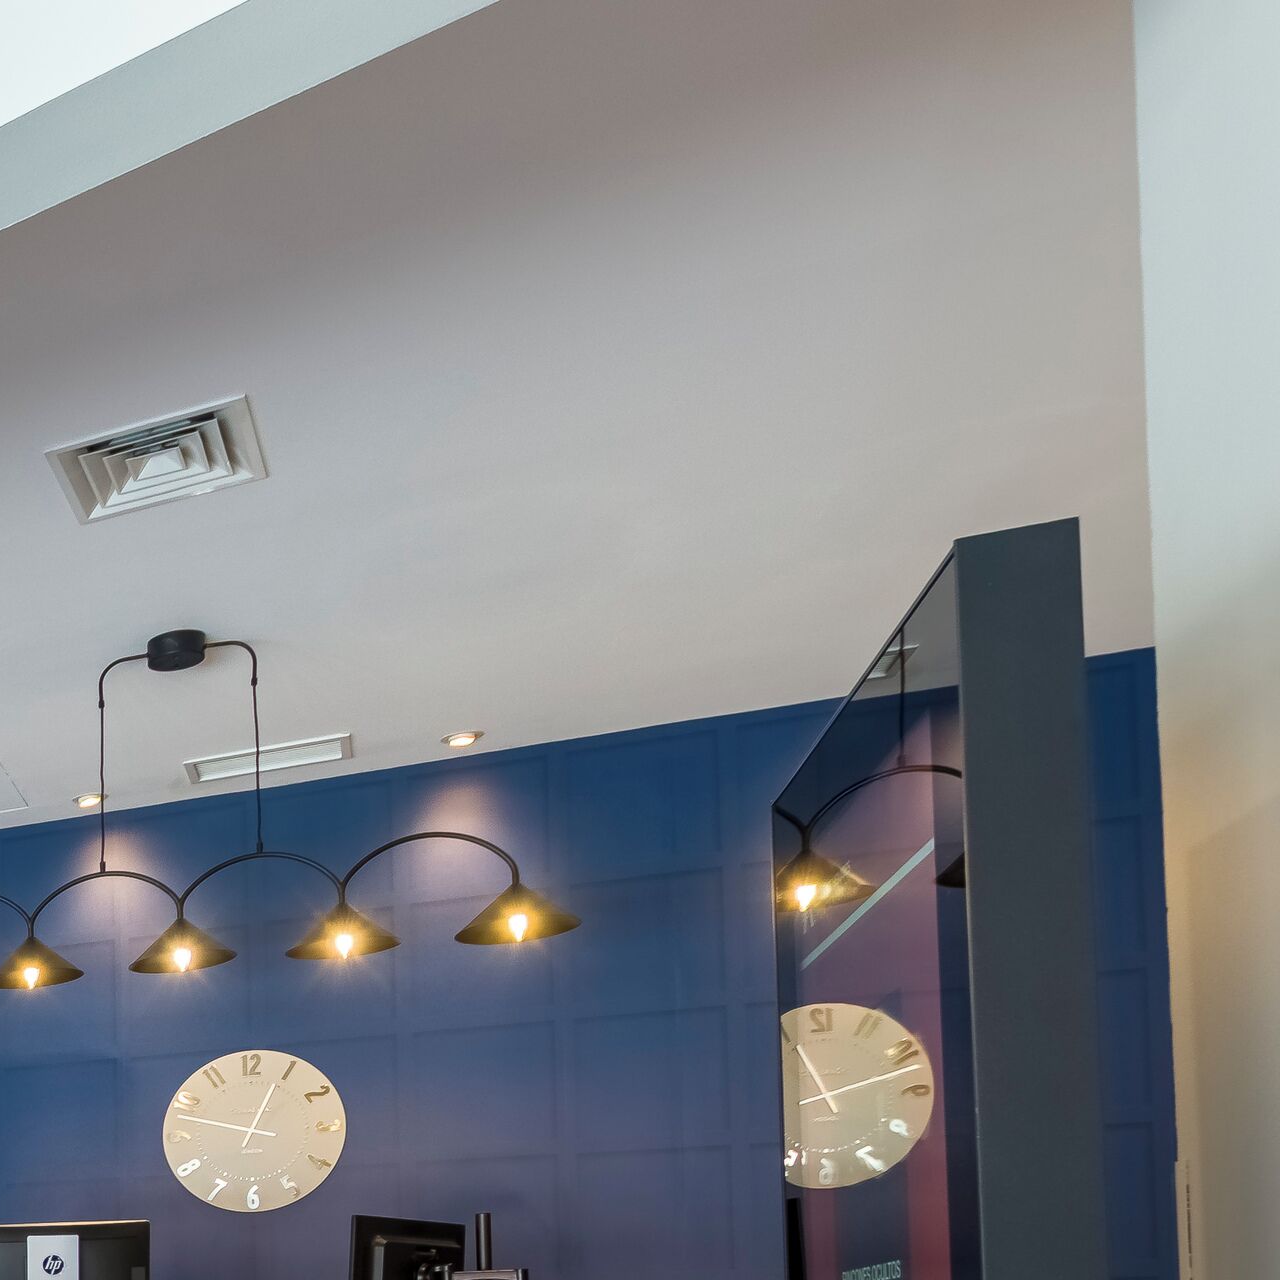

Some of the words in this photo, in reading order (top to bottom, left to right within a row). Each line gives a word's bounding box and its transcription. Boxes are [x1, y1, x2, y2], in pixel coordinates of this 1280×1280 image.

[240, 1053, 262, 1076] 12
[281, 1060, 297, 1081] 1
[202, 1064, 226, 1089] 11
[173, 1090, 201, 1113] 10
[304, 1083, 331, 1104] 2
[166, 1129, 192, 1144] 9
[315, 1119, 342, 1133] 3
[176, 1158, 202, 1178] 8
[307, 1154, 332, 1171] 4
[207, 1177, 228, 1201] 7
[279, 1174, 301, 1198] 5
[246, 1184, 260, 1210] 6
[43, 1255, 63, 1275] hp
